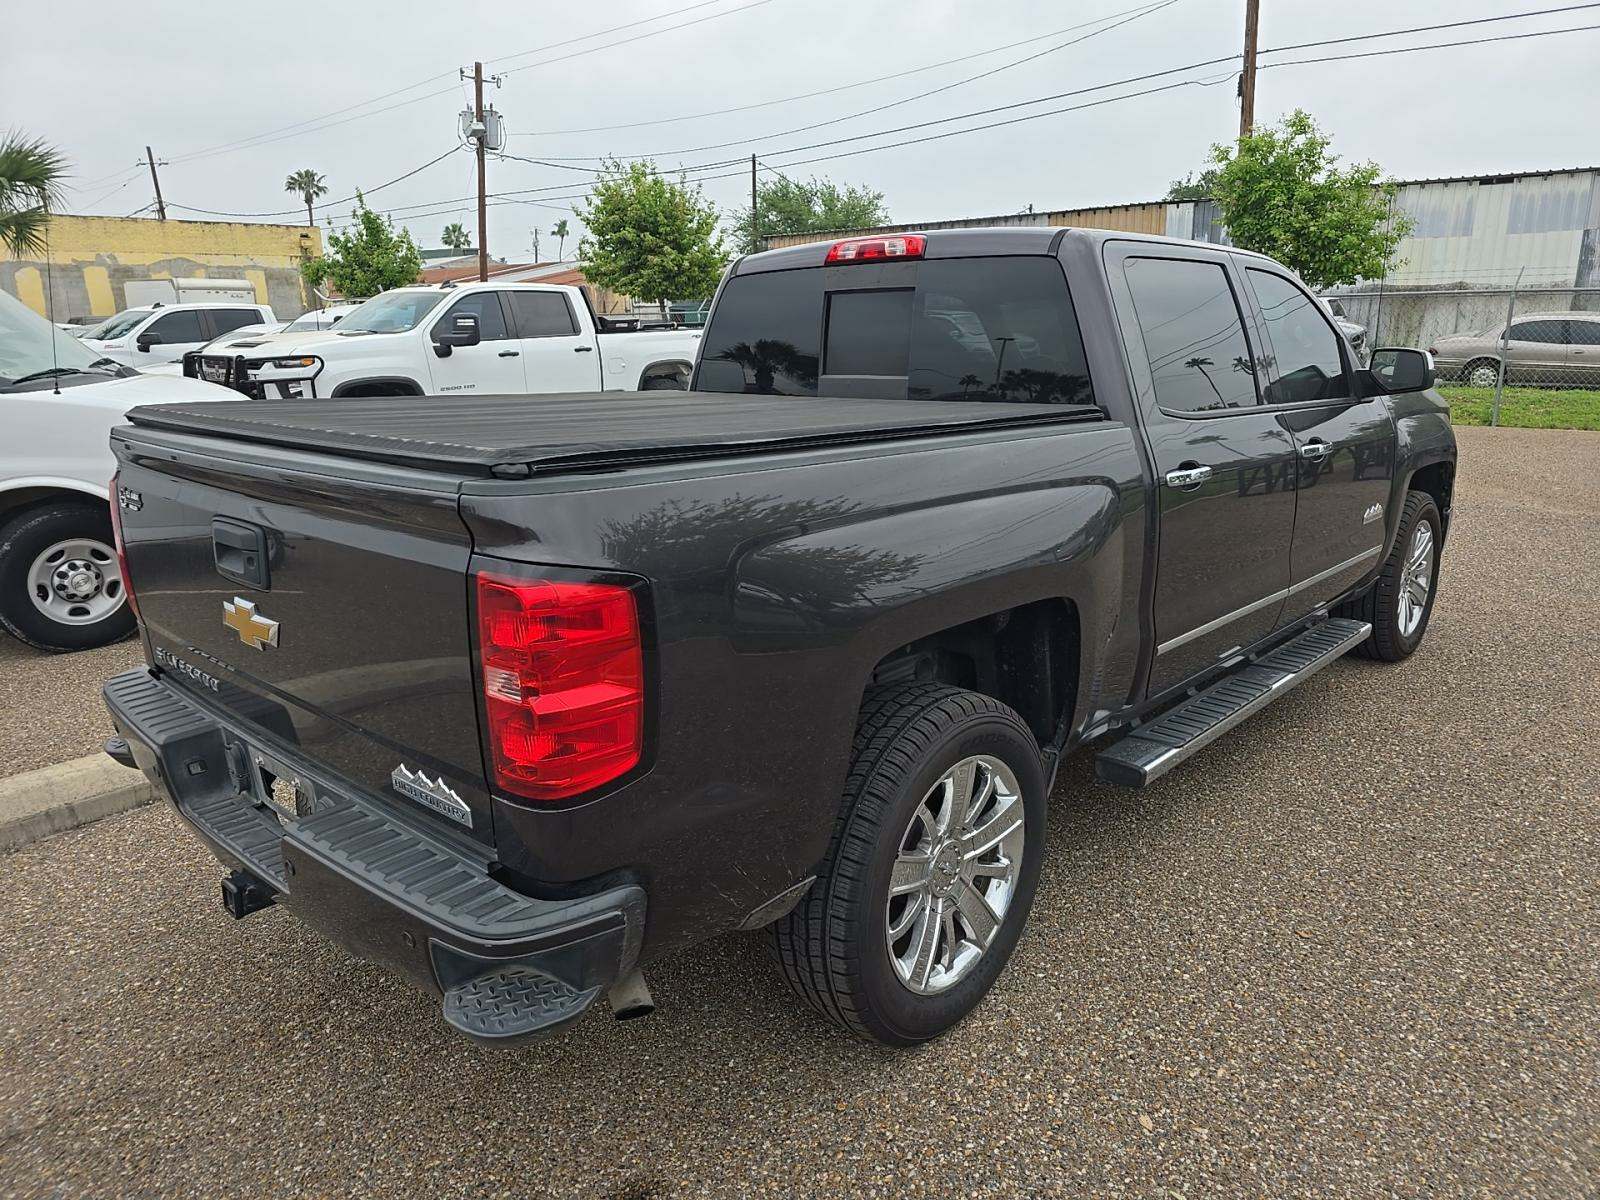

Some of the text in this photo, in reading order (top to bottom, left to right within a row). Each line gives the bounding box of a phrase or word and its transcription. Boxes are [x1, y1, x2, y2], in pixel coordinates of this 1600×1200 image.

[155, 646, 220, 693] SILVERADO
[394, 777, 467, 820] HIGH COUNTRY
